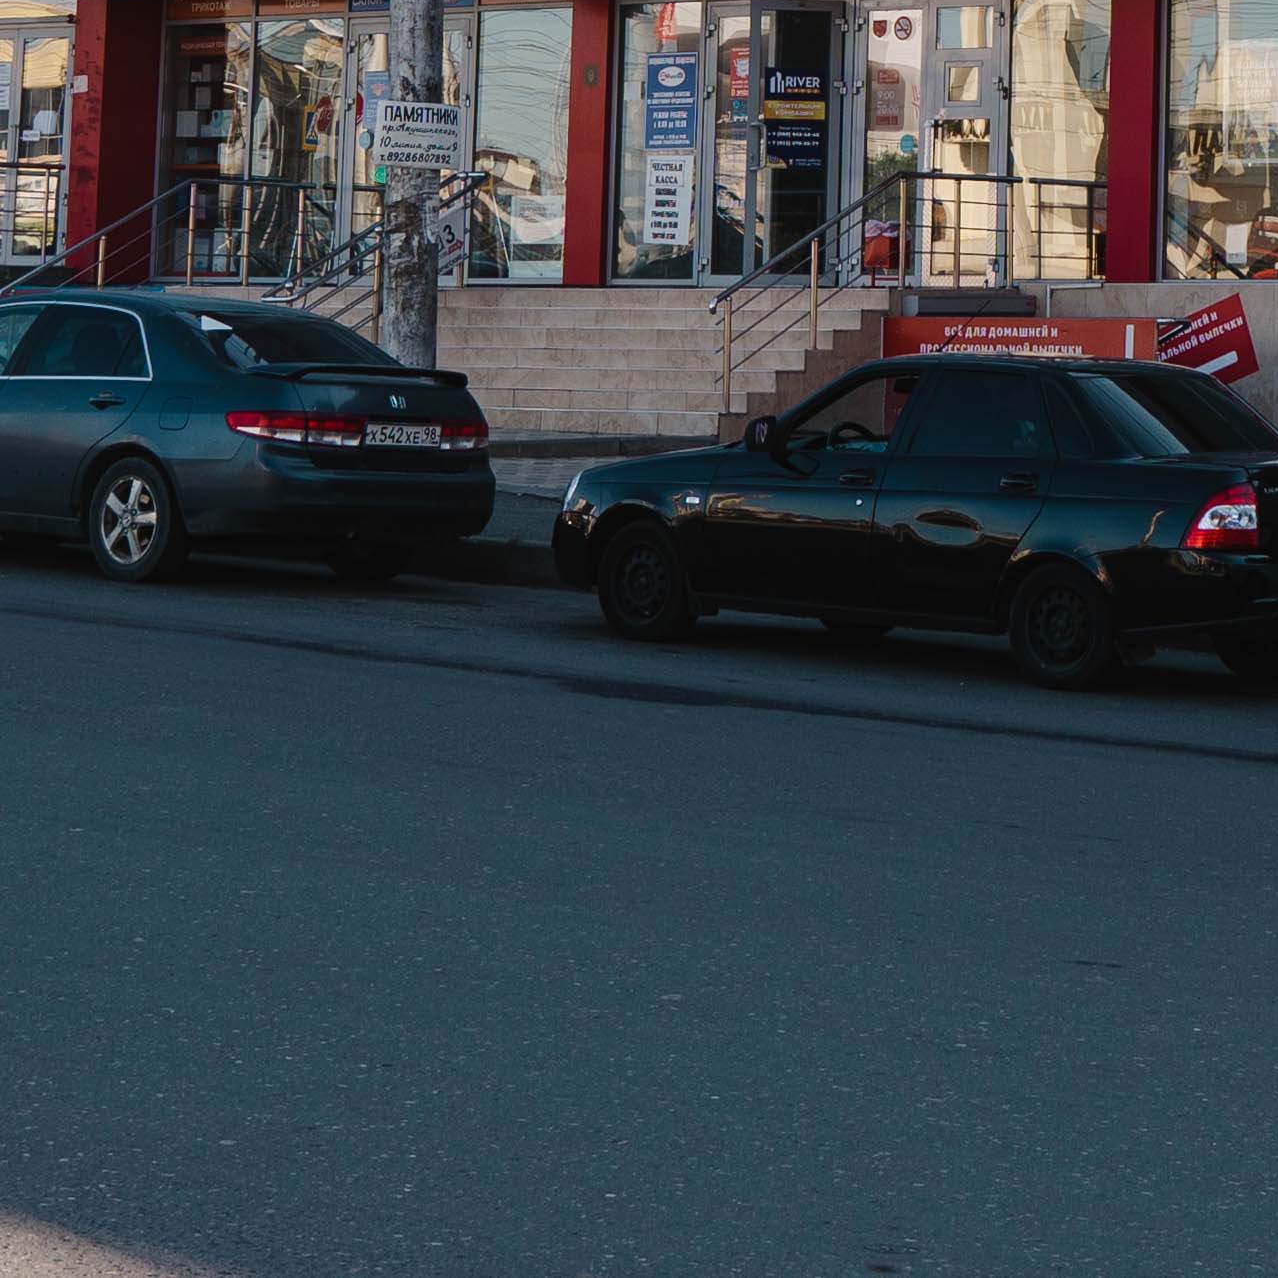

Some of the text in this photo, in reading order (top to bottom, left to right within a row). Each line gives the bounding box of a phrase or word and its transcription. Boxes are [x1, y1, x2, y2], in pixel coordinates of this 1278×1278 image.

[785, 76, 820, 88] RIVER
[384, 105, 458, 126] ПАМЯТНИКИ
[965, 326, 987, 339] ДЛЯ
[988, 325, 1049, 339] ДОМАШНЕЙ
[1050, 327, 1058, 338] И
[1199, 315, 1245, 344] ВЫПЕЧКИ
[370, 426, 437, 444] Х542ХЕ 98
